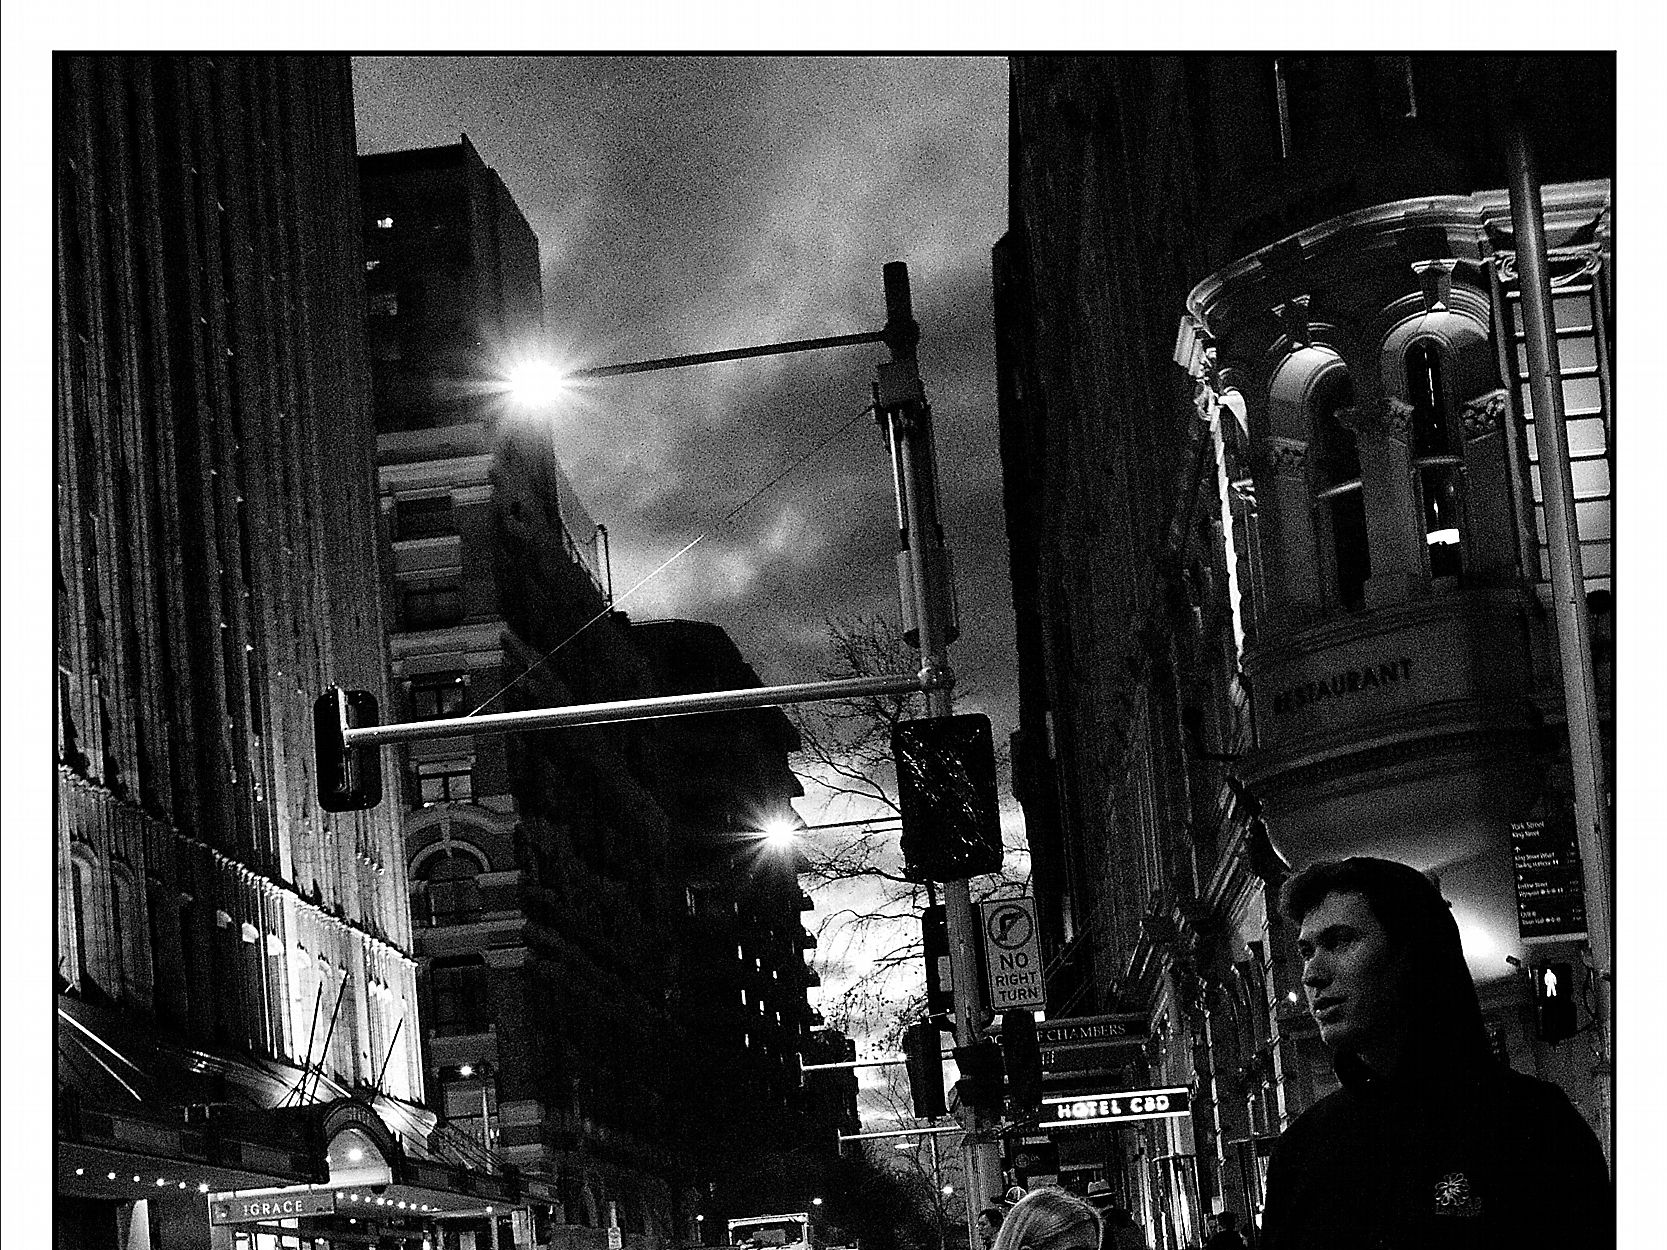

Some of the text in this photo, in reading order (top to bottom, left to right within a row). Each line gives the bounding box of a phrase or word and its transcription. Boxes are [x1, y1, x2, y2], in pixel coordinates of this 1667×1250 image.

[1273, 657, 1413, 714] RESTAURANT
[1000, 952, 1028, 970] NO
[996, 971, 1036, 987] RIGHT
[999, 987, 1038, 1002] TURN
[1046, 1023, 1126, 1041] CHAMBERS
[1057, 1095, 1170, 1119] HOTEL CBD
[250, 1200, 303, 1216] GRACE
